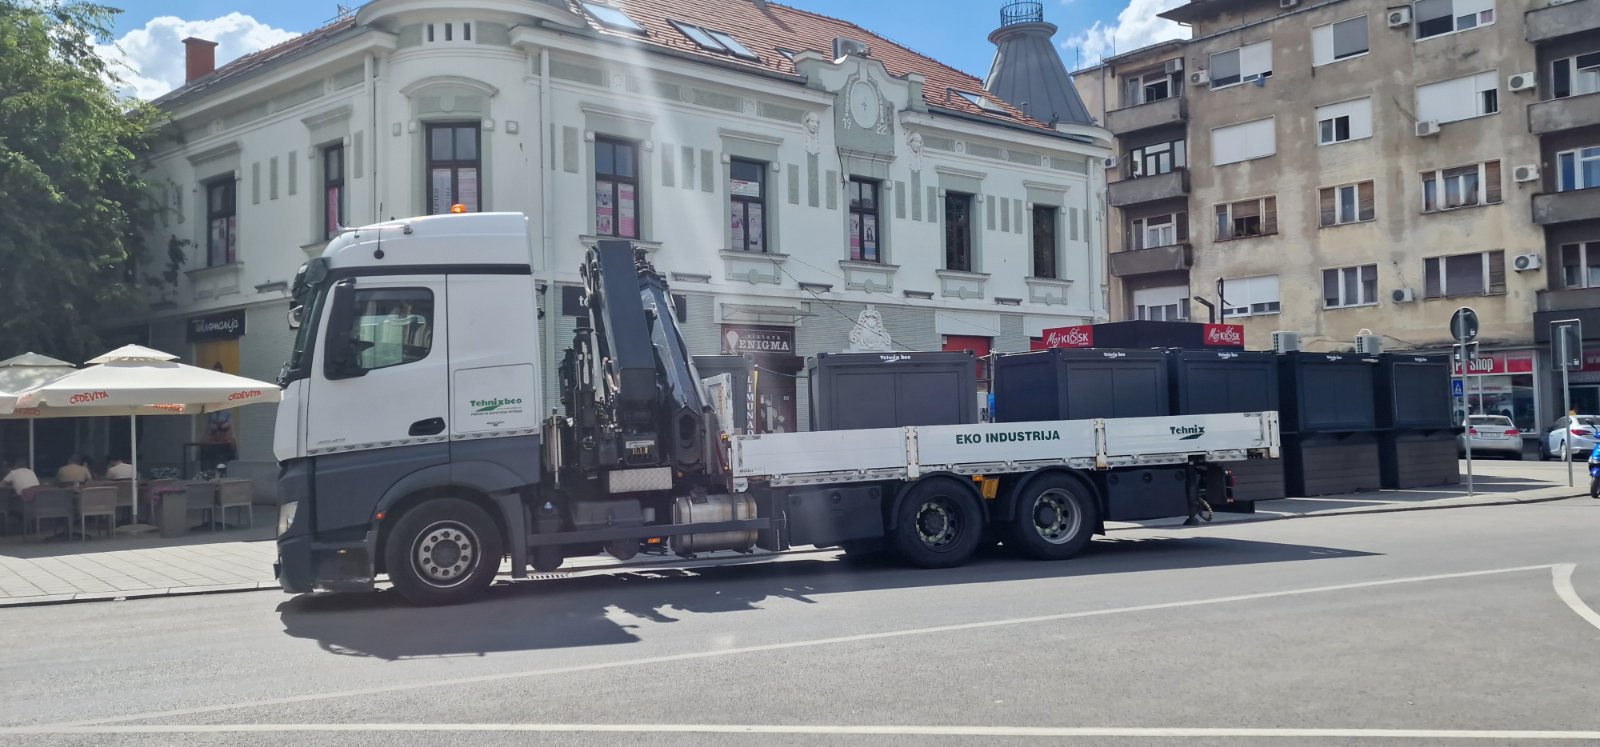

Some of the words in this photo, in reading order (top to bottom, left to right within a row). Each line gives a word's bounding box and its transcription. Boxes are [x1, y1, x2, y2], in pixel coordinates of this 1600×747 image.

[841, 117, 851, 130] 19
[877, 123, 887, 135] 22
[1046, 332, 1061, 348] Moj
[1061, 332, 1089, 344] KIOSK
[1208, 328, 1220, 343] Moj
[738, 340, 790, 351] ENIGMA
[70, 390, 109, 404] CEDEVITA
[228, 389, 262, 401] CEDEVITA
[1169, 424, 1205, 435] Tehnix
[955, 433, 982, 444] EKO
[985, 430, 1061, 443] INDUSTRIJA
